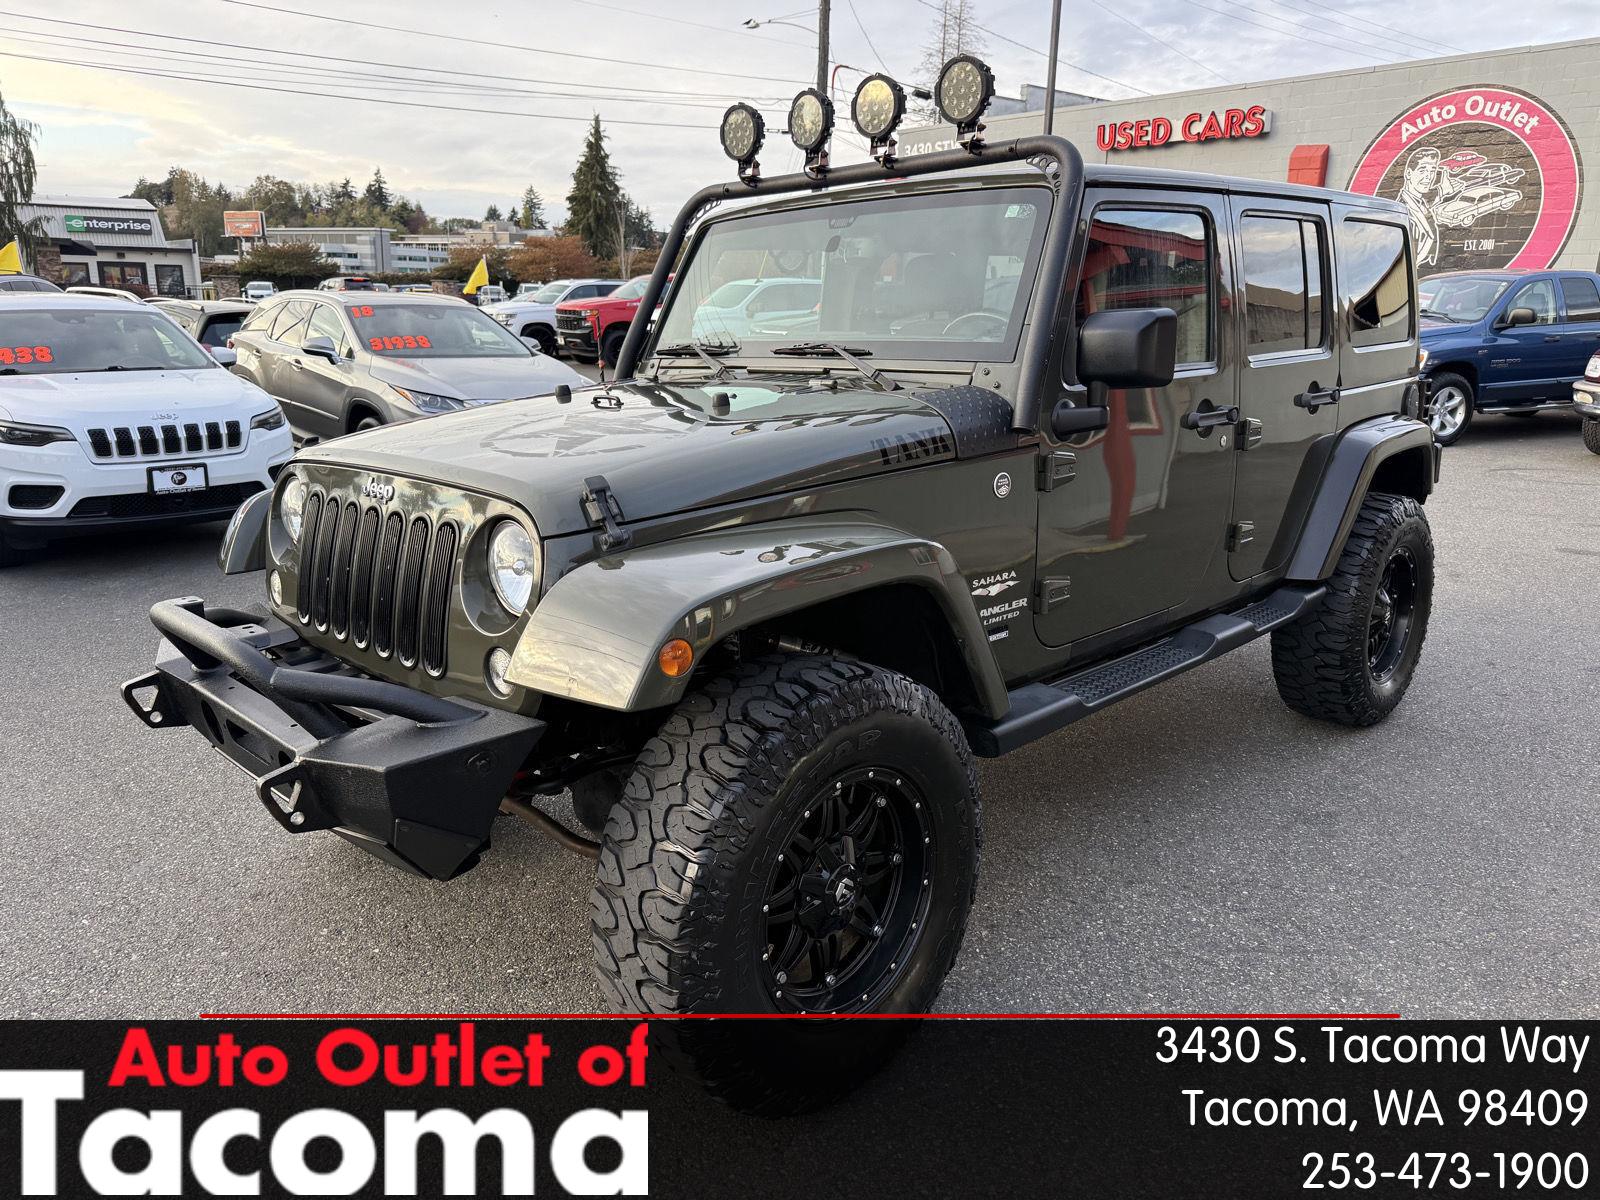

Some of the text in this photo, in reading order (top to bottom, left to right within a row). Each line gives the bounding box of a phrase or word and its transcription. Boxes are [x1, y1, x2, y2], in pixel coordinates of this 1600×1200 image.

[1400, 95, 1541, 143] Auto Outlet
[1096, 105, 1266, 151] USED CARS
[904, 142, 932, 156] 3430
[67, 216, 151, 231] enterprise
[1478, 238, 1496, 250] 2001
[351, 305, 374, 318] 18
[870, 426, 951, 466] TANK
[362, 476, 394, 503] Jeep
[972, 570, 1017, 588] SAHARA
[983, 610, 1020, 626] LIMITED
